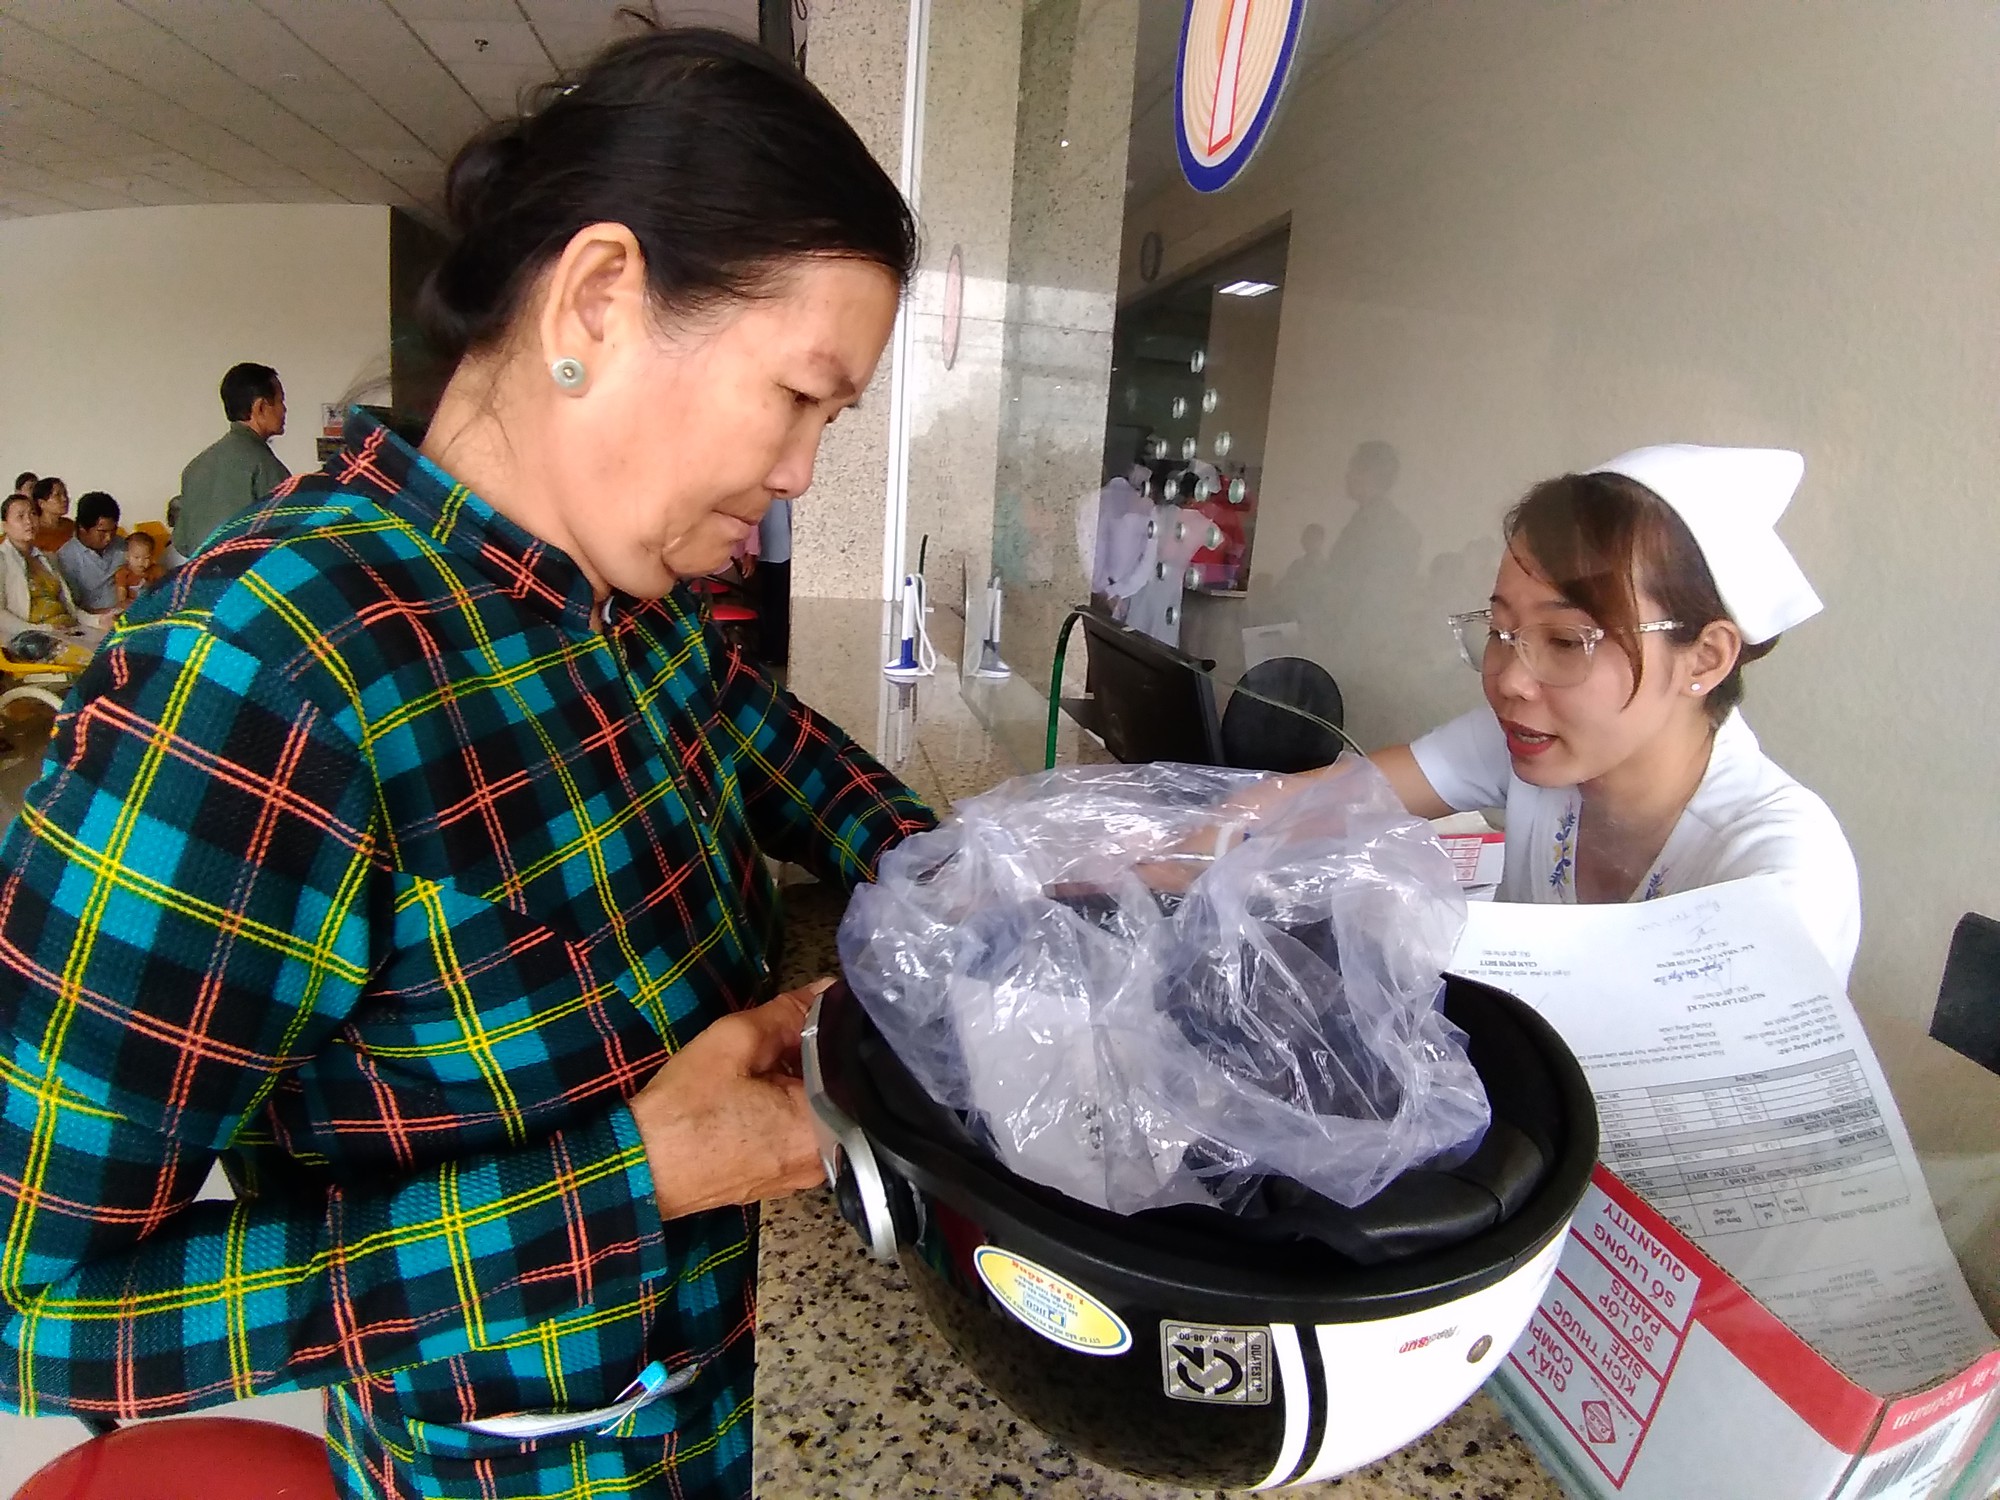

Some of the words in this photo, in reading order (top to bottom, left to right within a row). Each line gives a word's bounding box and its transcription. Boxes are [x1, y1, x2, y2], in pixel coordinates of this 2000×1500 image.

[1603, 1203, 1685, 1282] QUANTITY
[1599, 1294, 1629, 1328] LỚP
[1611, 1279, 1662, 1336] PARTS
[1649, 1280, 1676, 1308] SỐ
[1610, 1338, 1643, 1379] SIZE
[1629, 1325, 1654, 1352] SỐ
[1527, 1344, 1566, 1392] GIẤY
[1602, 1353, 1636, 1397] KÍCH
